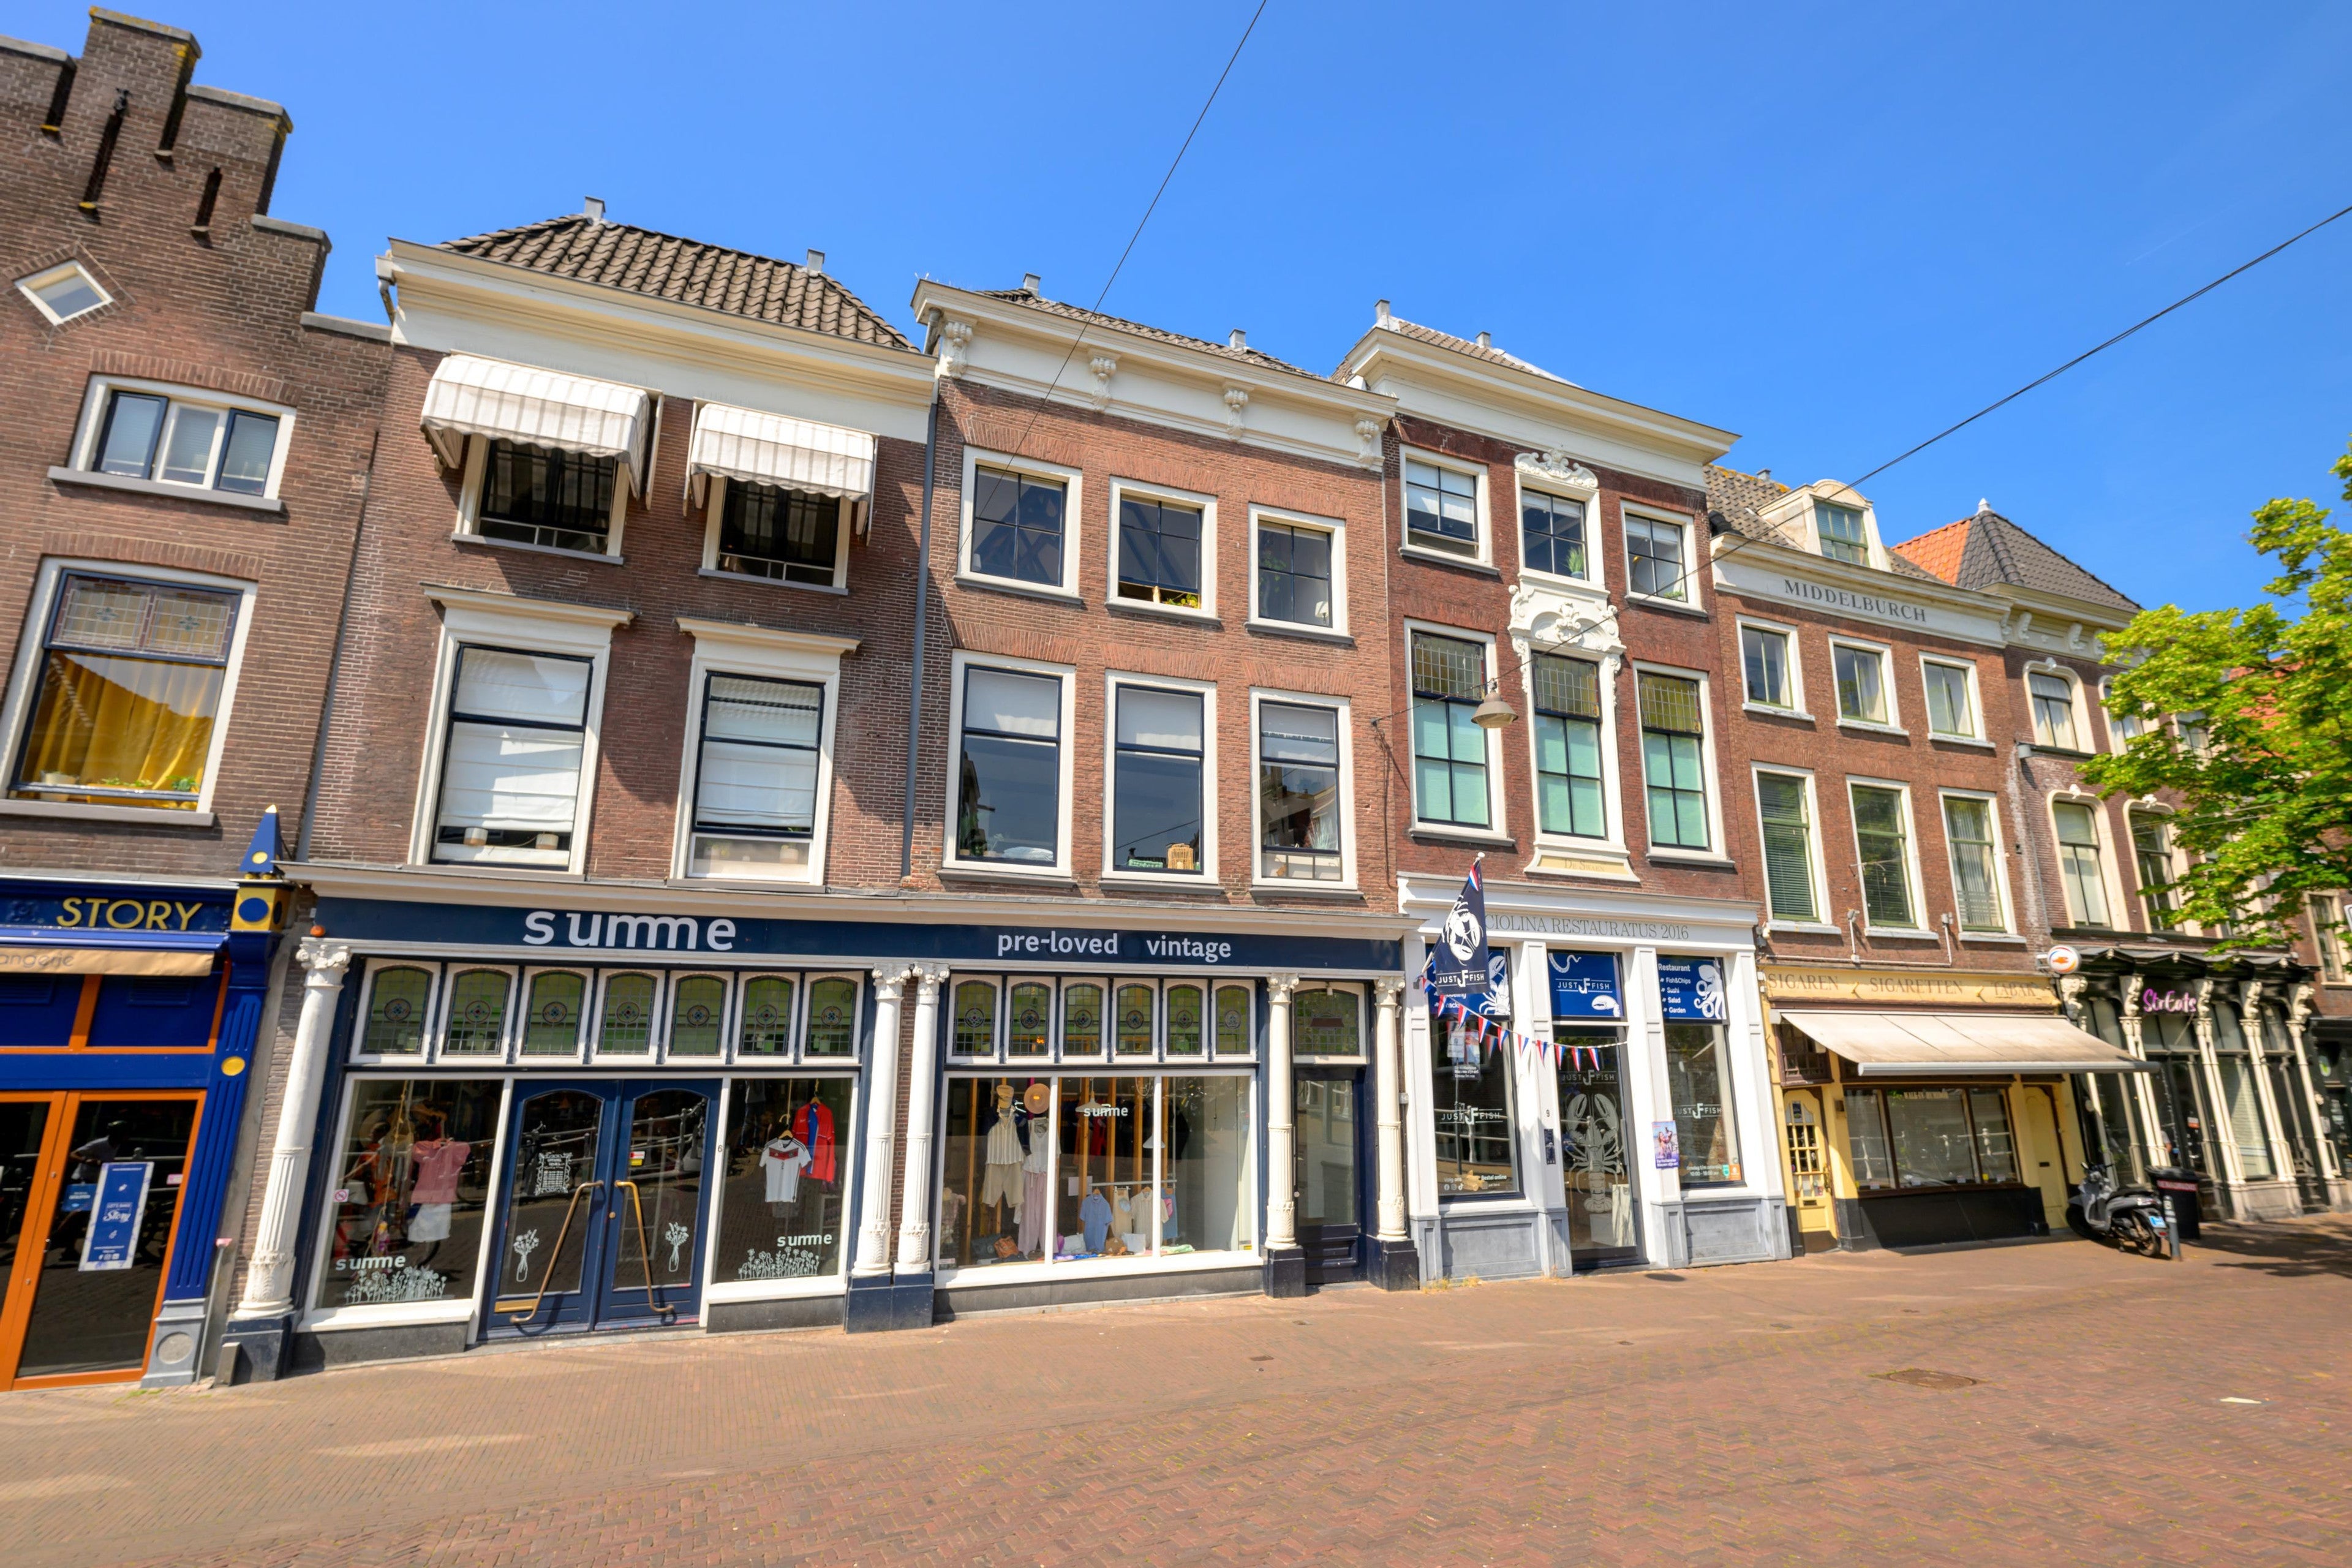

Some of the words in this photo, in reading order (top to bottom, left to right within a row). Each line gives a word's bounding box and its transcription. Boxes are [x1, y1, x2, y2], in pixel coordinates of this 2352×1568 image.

[1784, 579, 1926, 622] MIDDELBURCH
[56, 897, 203, 931] STORY
[522, 910, 736, 951] summe
[1551, 918, 1657, 939] RESTAURATUS
[1660, 924, 1689, 940] 2016
[997, 930, 1118, 957] pre-loved
[1146, 934, 1232, 963] vintage
[1658, 963, 1691, 972] Restaurant
[1438, 975, 1457, 984] JUST
[1768, 973, 1839, 991] SIGAREN
[1869, 976, 1963, 994] SIGARETTEN
[2143, 988, 2196, 1012] StrEats
[1084, 1107, 1129, 1117] summe
[777, 1234, 833, 1247] summe
[335, 1255, 406, 1271] summe
